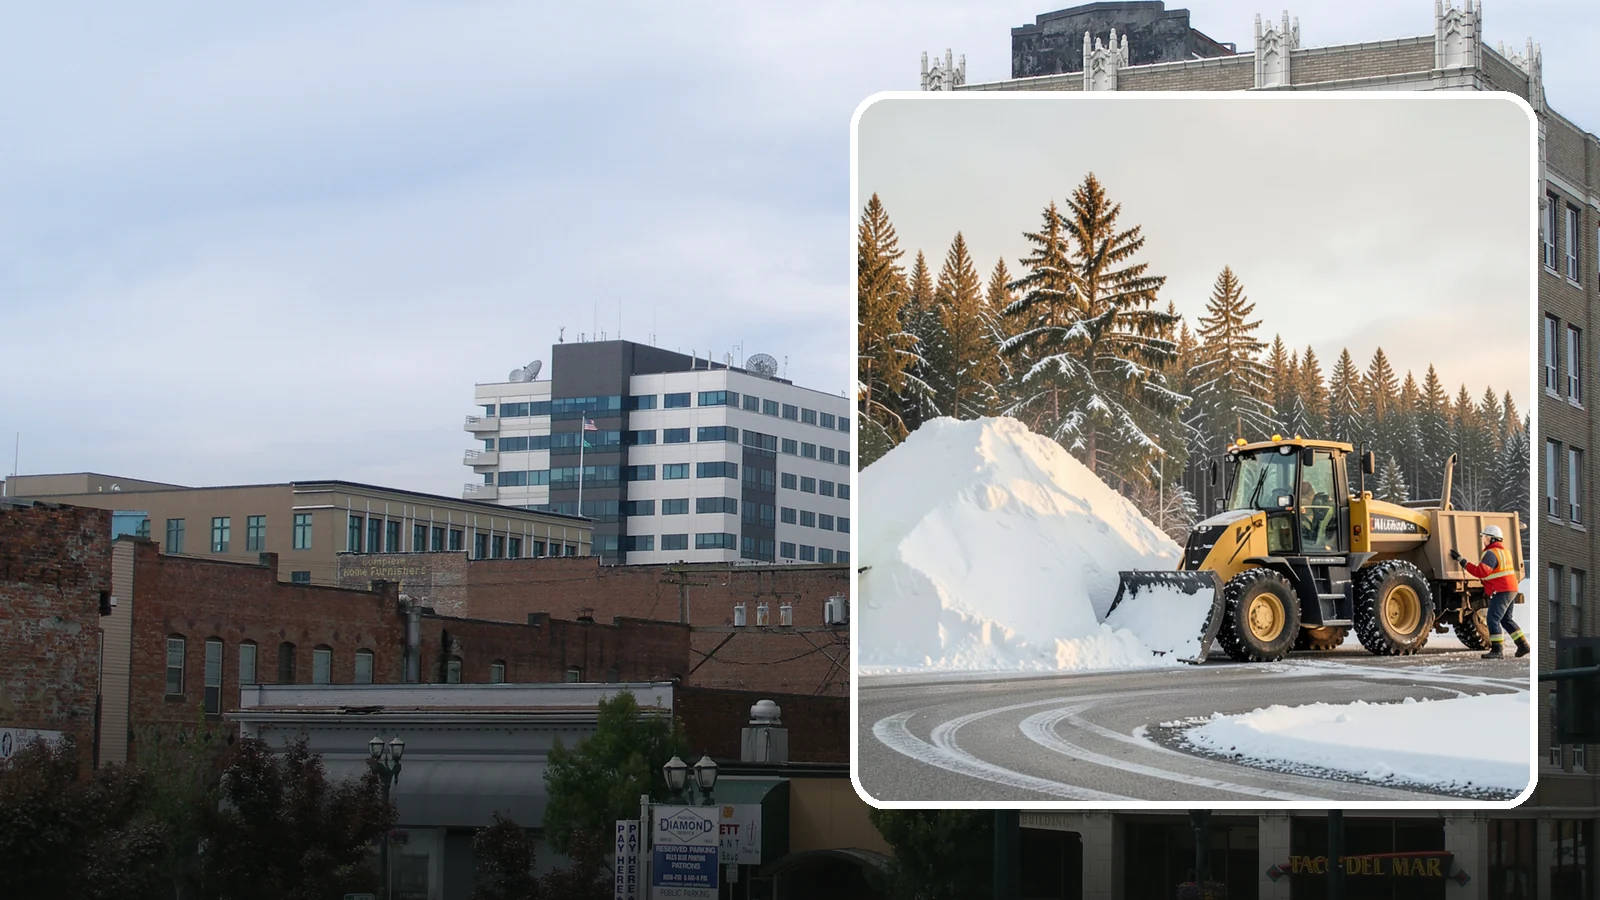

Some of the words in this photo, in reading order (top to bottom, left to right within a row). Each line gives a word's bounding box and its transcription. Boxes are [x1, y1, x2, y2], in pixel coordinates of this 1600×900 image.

[343, 568, 368, 577] Home
[370, 566, 427, 576] Furnishers
[660, 817, 713, 833] DIAMOND
[1021, 814, 1070, 828] BUILDING
[617, 824, 625, 853] PAY
[628, 824, 637, 853] PAY
[655, 845, 688, 853] RESERVED
[689, 846, 716, 854] PARKING
[721, 851, 739, 862] Soup
[671, 861, 701, 870] PATRONS
[1346, 857, 1384, 876] DEL
[1392, 857, 1442, 877] MAR
[616, 856, 625, 894] HERE
[627, 855, 637, 894] HERE
[660, 888, 682, 897] PUBLIC
[683, 889, 710, 898] PARKING
